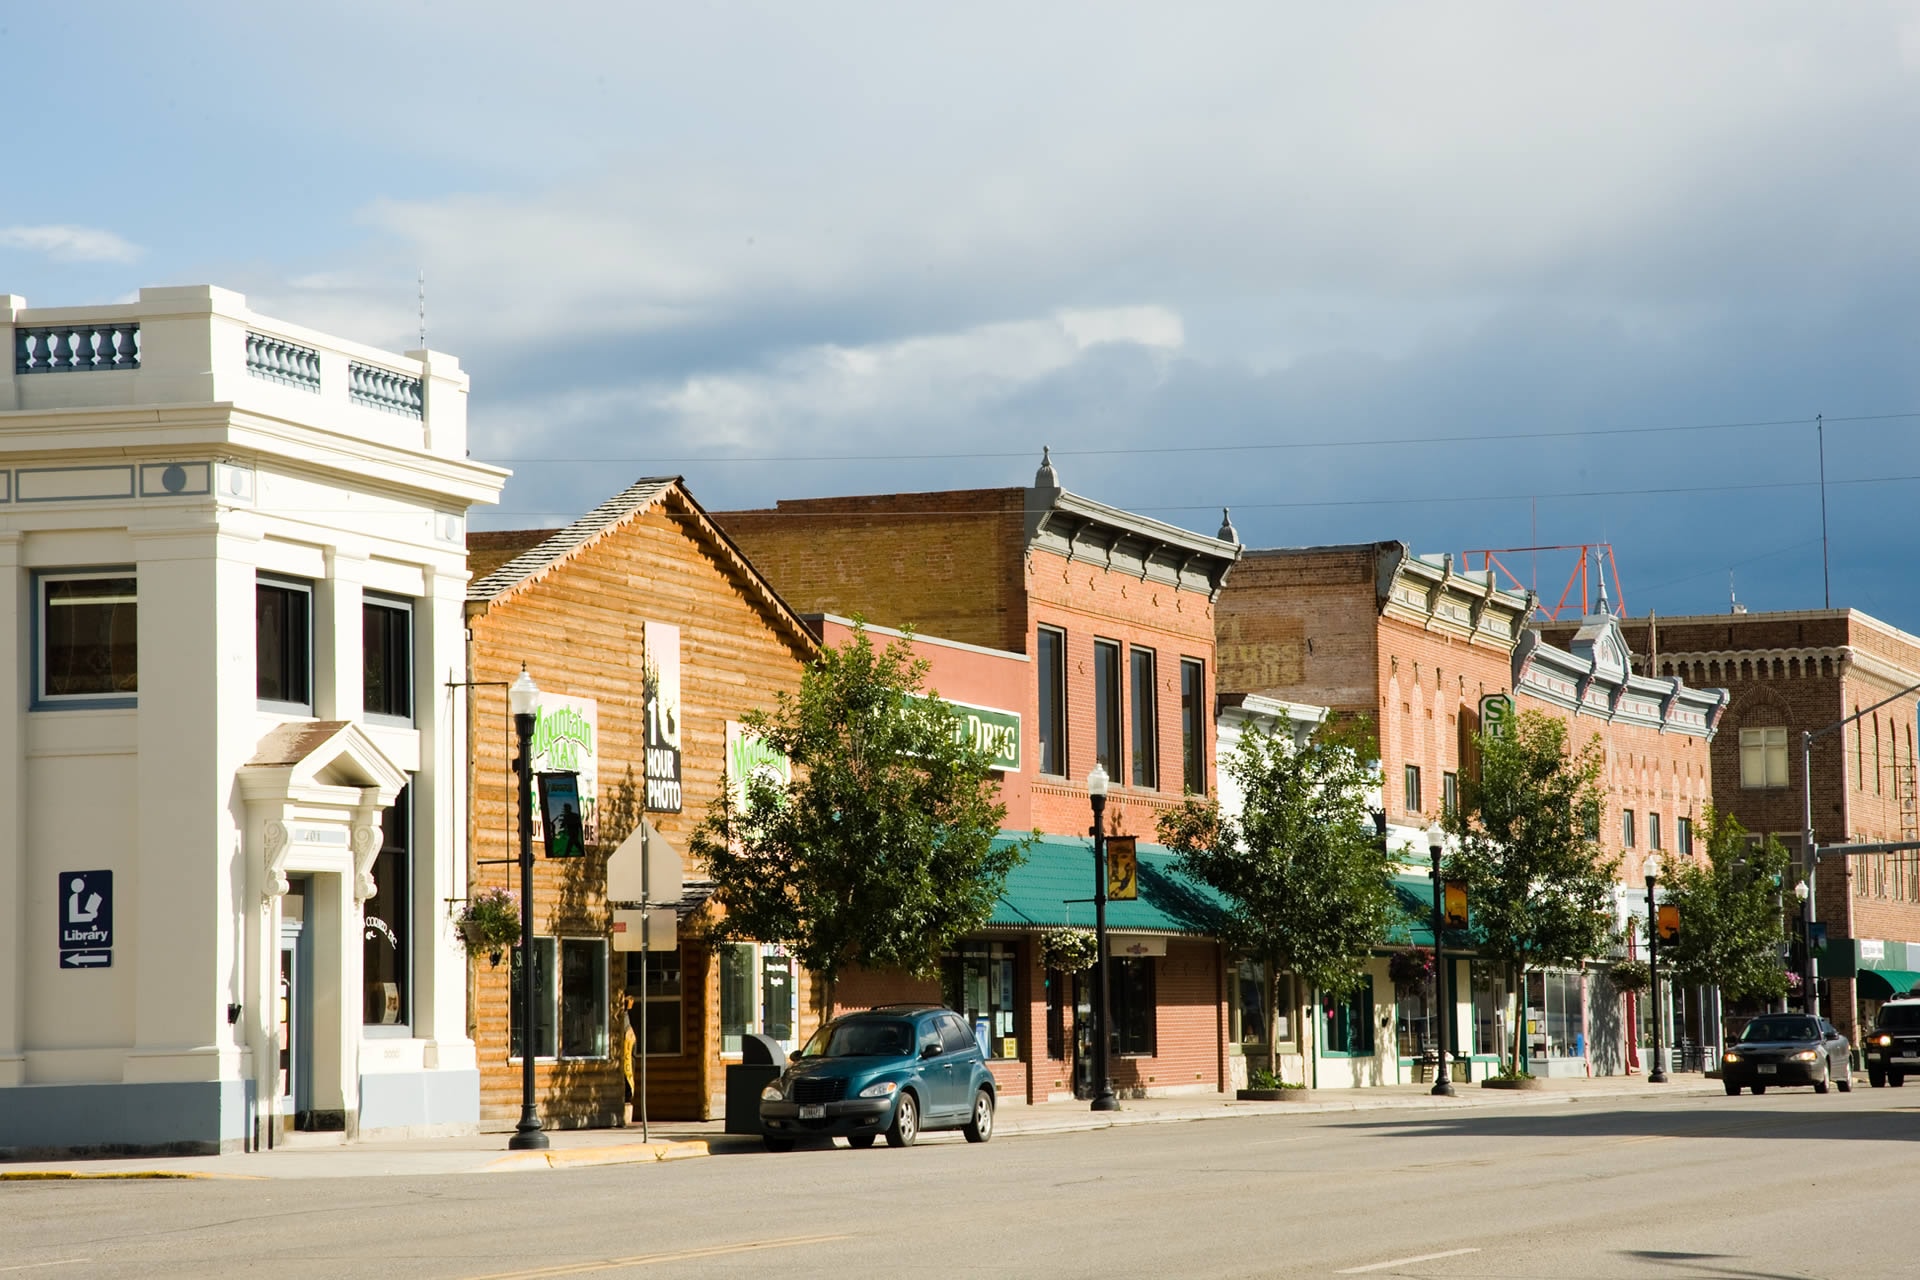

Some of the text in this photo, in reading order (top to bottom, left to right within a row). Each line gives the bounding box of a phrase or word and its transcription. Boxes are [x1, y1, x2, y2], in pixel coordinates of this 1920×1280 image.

[967, 715, 1017, 761] DRUG
[547, 743, 578, 769] MAN
[647, 748, 675, 779] HOUR
[647, 779, 682, 810] PHOTO
[64, 929, 108, 942] Library
